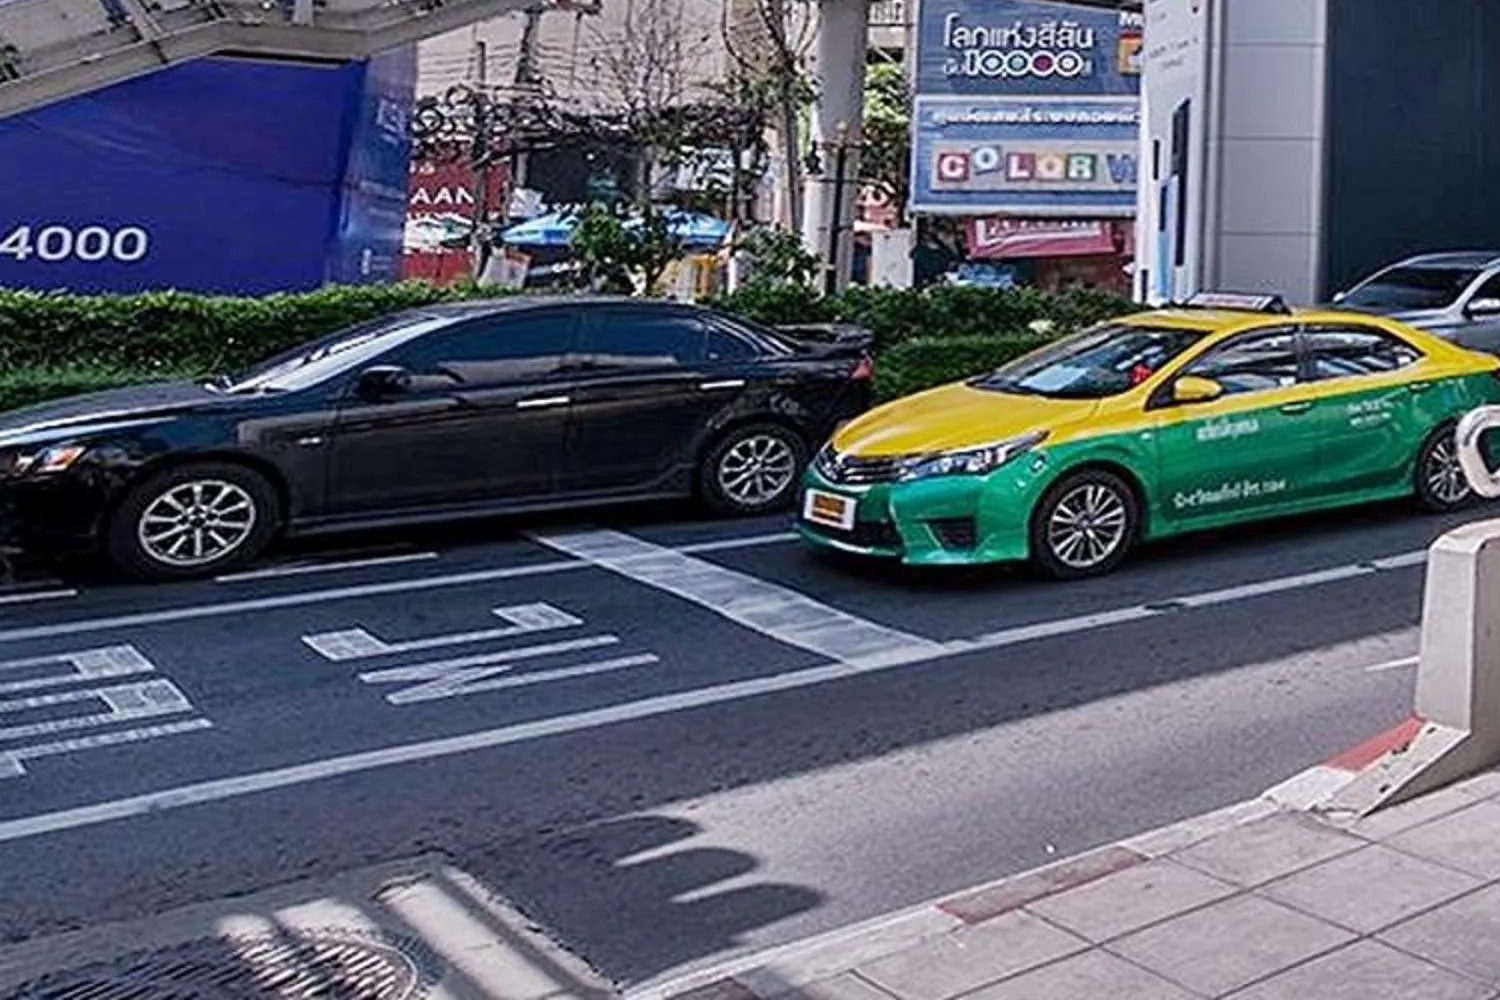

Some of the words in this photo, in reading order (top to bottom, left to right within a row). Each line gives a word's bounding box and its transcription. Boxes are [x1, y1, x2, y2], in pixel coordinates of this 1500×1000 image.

[943, 13, 1093, 48] โลกแห่งสีสัน
[939, 146, 1097, 181] COLOR
[0, 226, 148, 261] 4000
